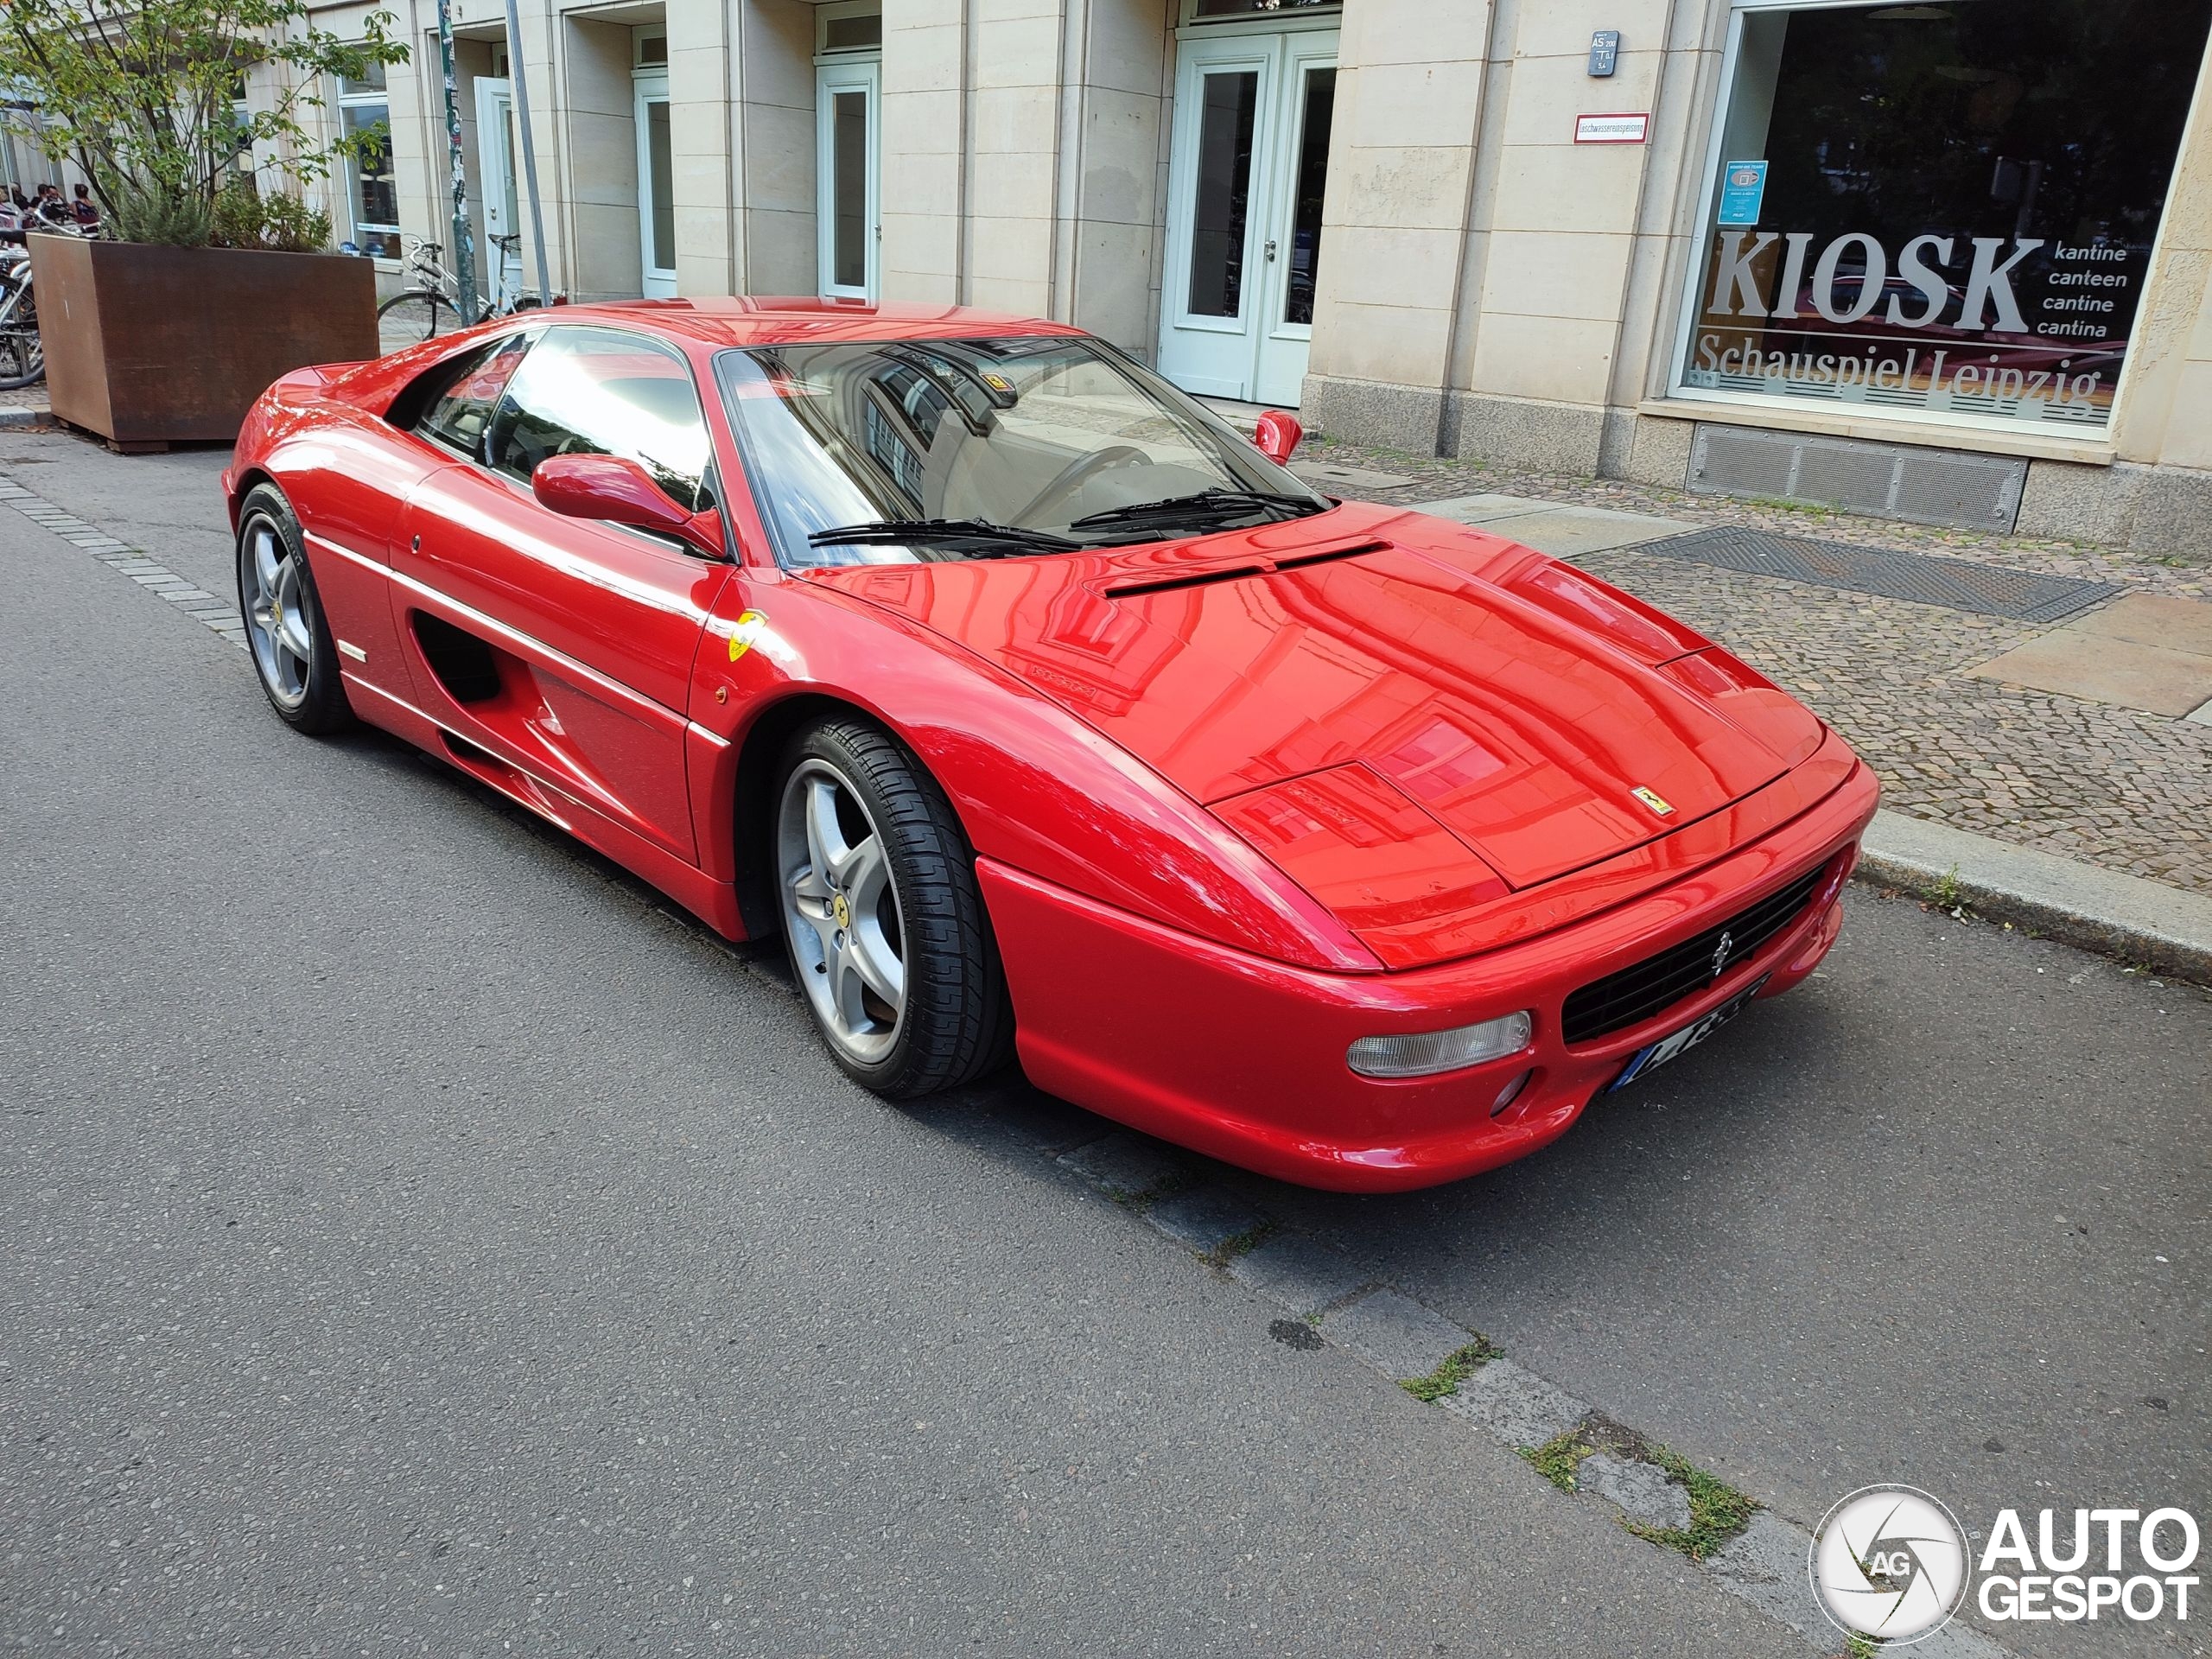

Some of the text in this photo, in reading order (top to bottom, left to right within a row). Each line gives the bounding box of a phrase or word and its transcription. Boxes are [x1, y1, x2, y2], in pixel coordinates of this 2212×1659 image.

[1592, 38, 1604, 48] AS
[1580, 122, 1643, 135] Löschwassereinspeisung
[2054, 241, 2127, 262] kantine
[1707, 232, 2044, 334] KIOSK
[2049, 270, 2128, 288] canteen
[2043, 295, 2115, 313] cantine
[2037, 319, 2107, 338] cantina
[1695, 334, 2101, 416] Schauspiel Leipzig
